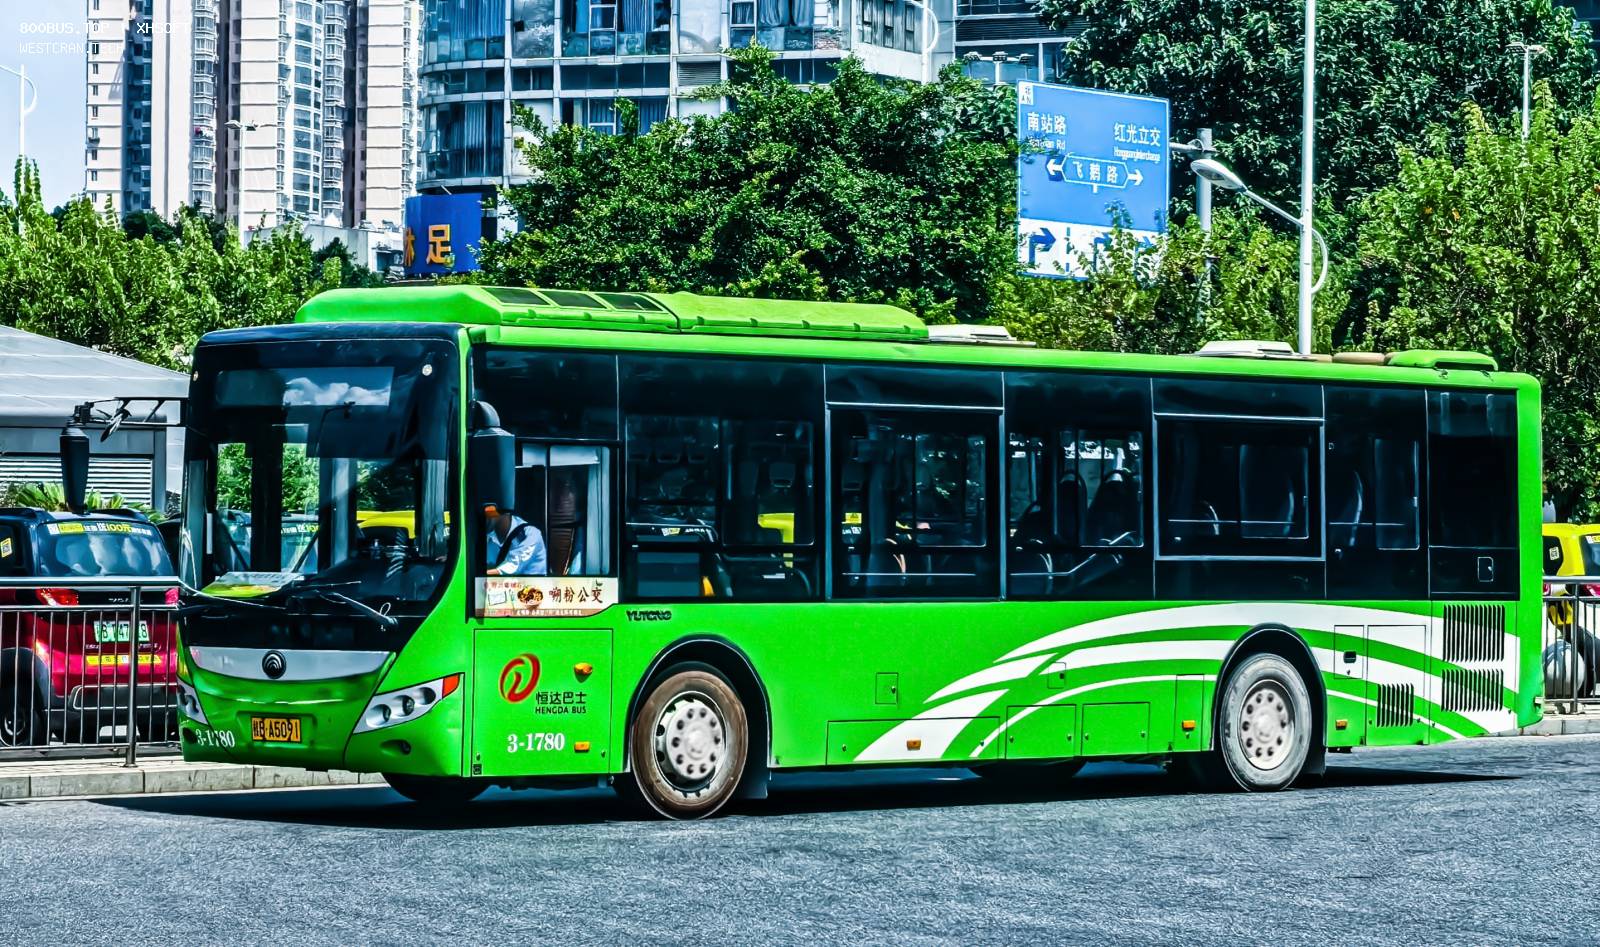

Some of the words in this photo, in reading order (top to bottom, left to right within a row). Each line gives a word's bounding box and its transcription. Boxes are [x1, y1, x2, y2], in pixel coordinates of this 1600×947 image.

[1028, 111, 1067, 135] 南站路
[1114, 122, 1161, 147] 红光立交
[535, 691, 587, 705] 恒达巴士
[535, 706, 569, 714] HENGDA
[571, 706, 587, 714] BUS
[195, 728, 236, 748] 3-1780
[507, 732, 565, 753] 3-1780
